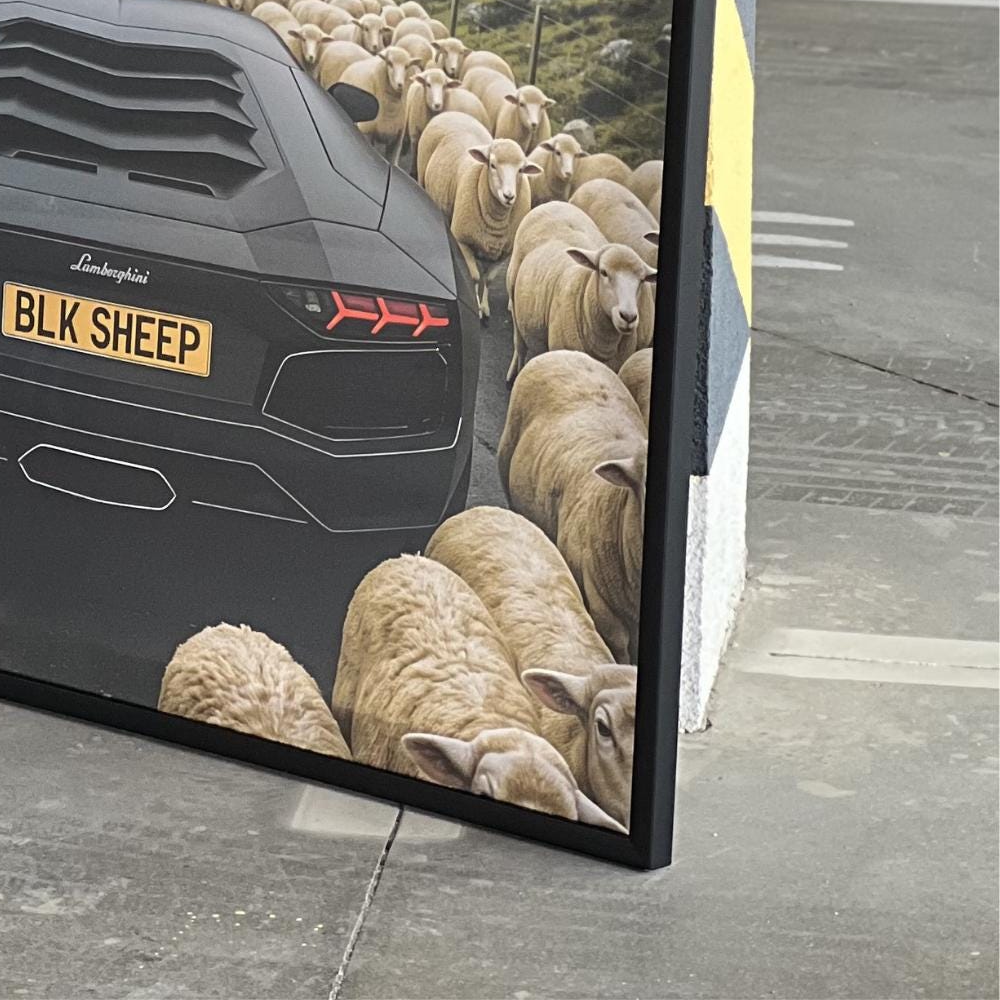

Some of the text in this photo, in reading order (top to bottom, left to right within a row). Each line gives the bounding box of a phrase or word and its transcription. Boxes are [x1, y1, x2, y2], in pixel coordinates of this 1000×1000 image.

[69, 253, 150, 285] Lamborghini
[14, 289, 201, 365] BLK SHEEP
